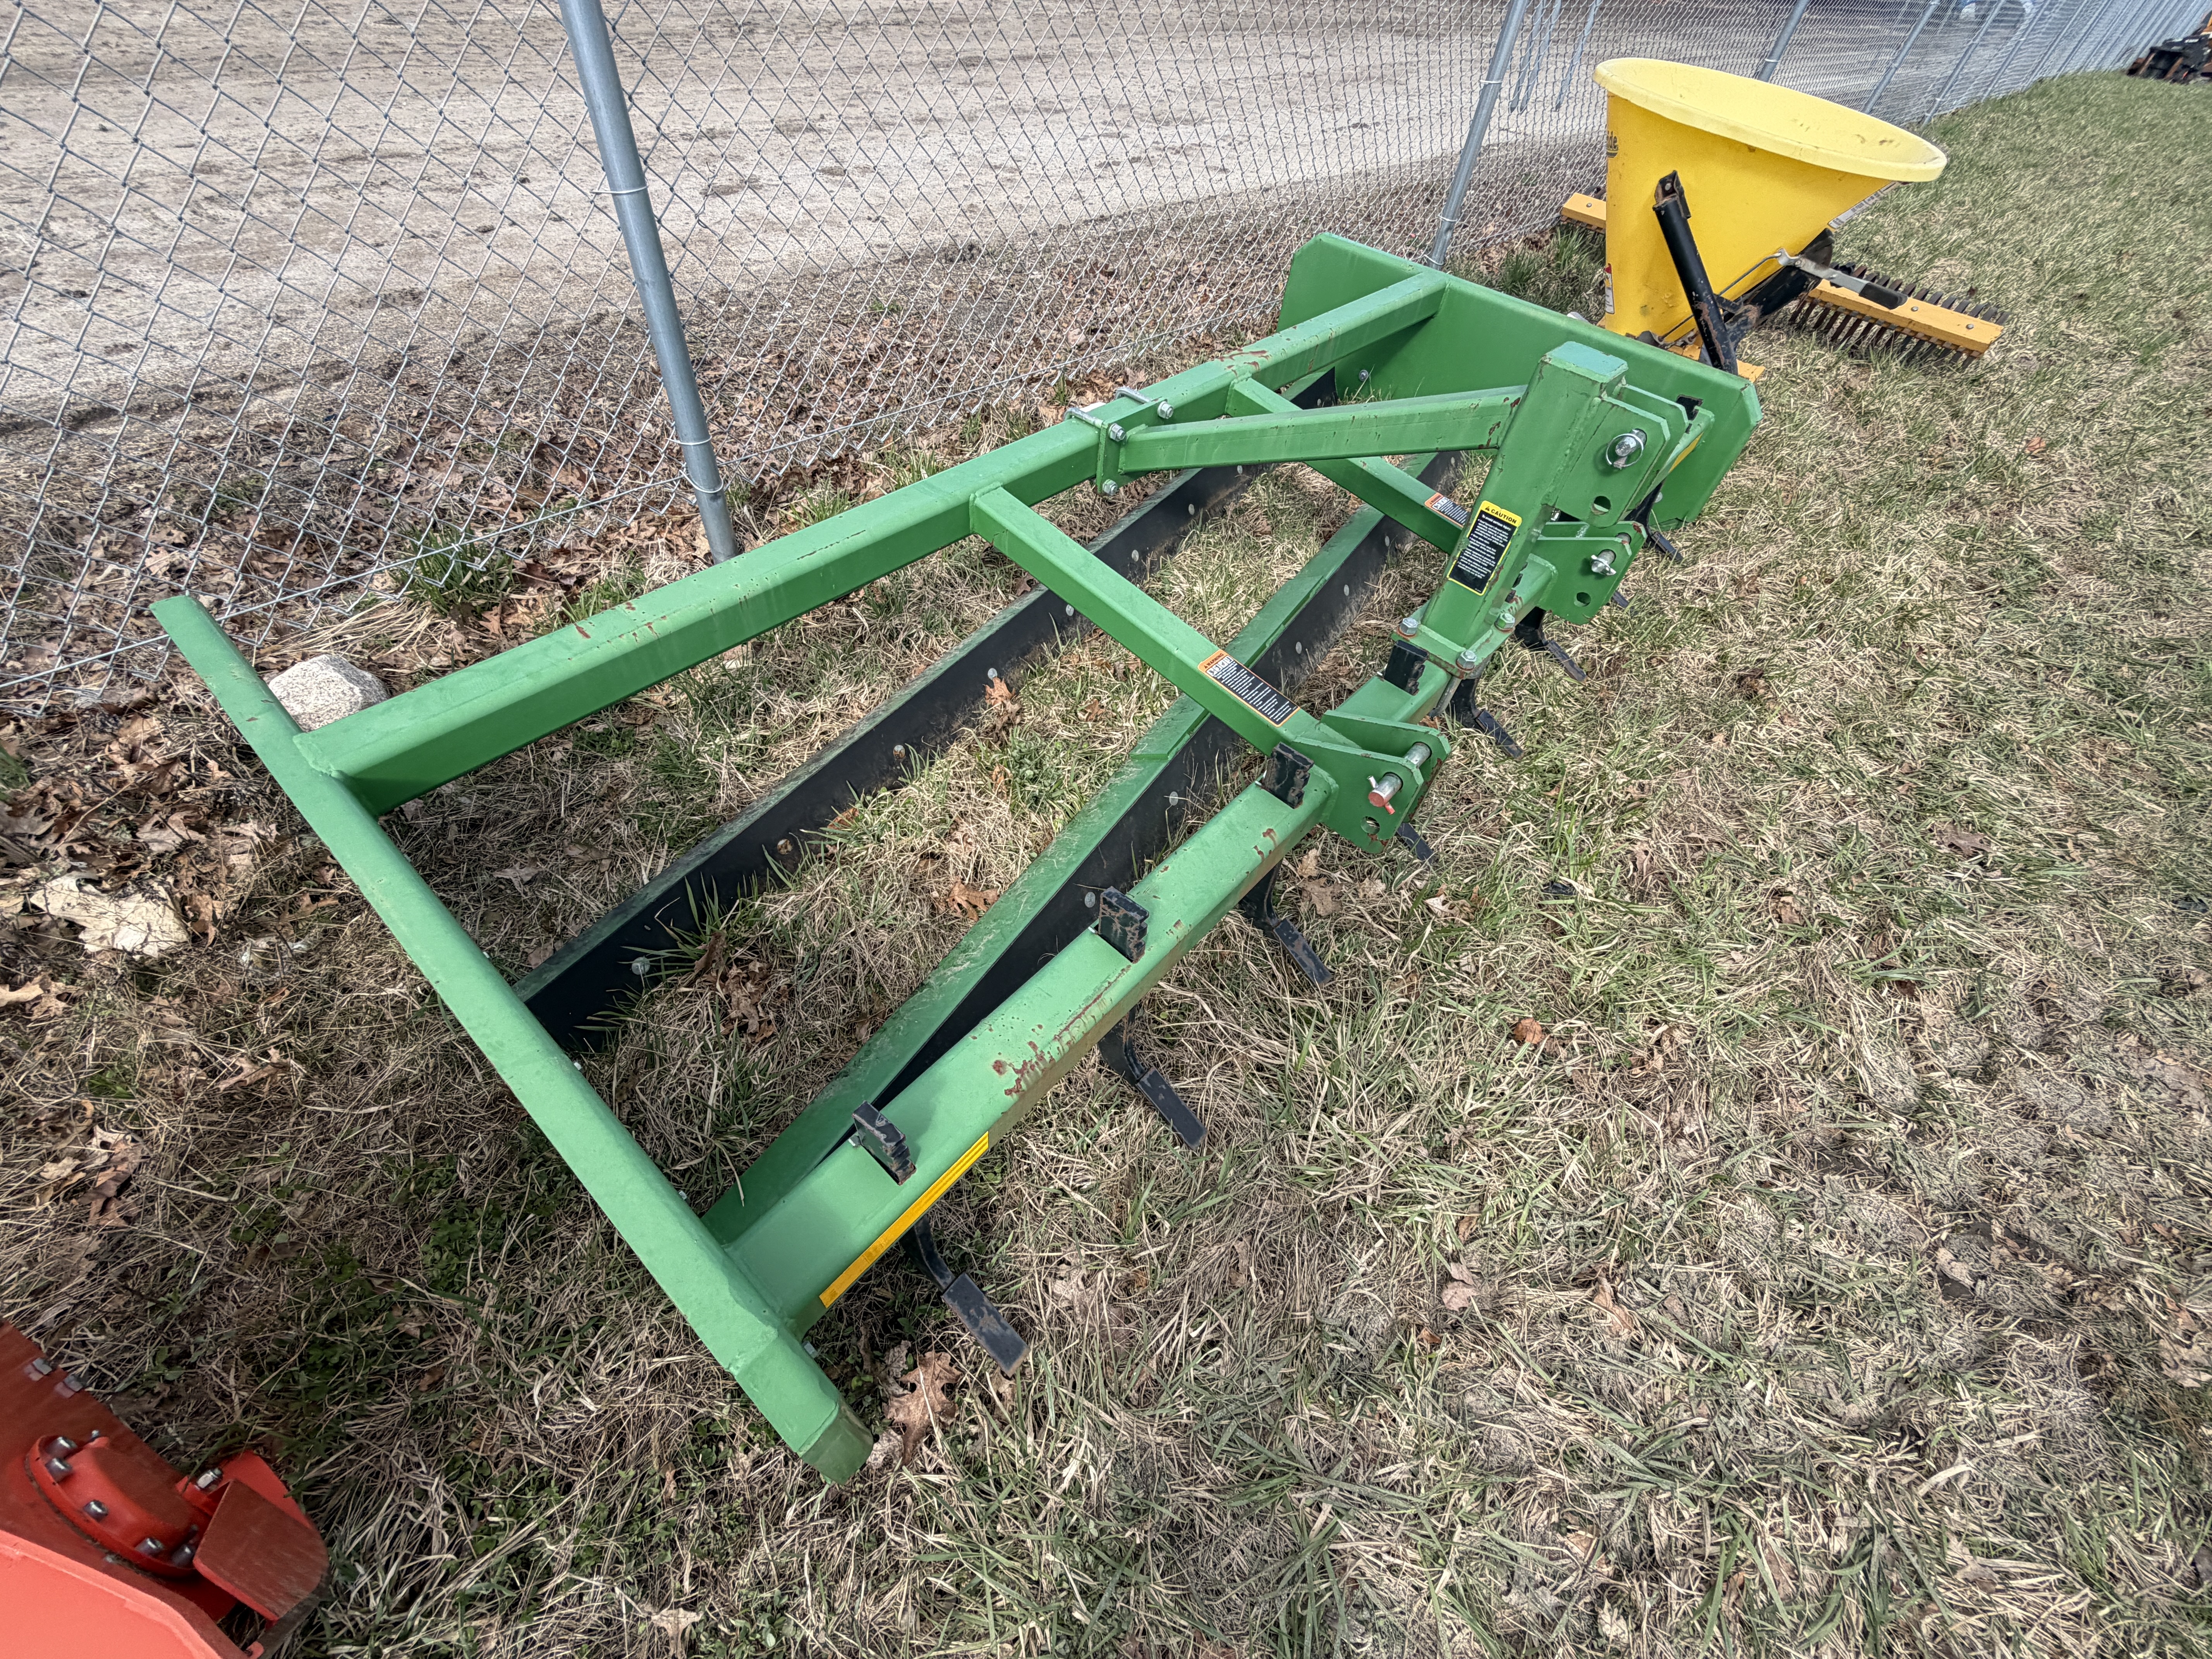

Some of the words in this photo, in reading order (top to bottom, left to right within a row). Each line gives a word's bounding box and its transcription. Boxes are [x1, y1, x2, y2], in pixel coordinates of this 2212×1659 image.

[1607, 130, 1617, 149] ide
[1491, 509, 1517, 524] CAUTION
[1206, 653, 1224, 666] WARNING
